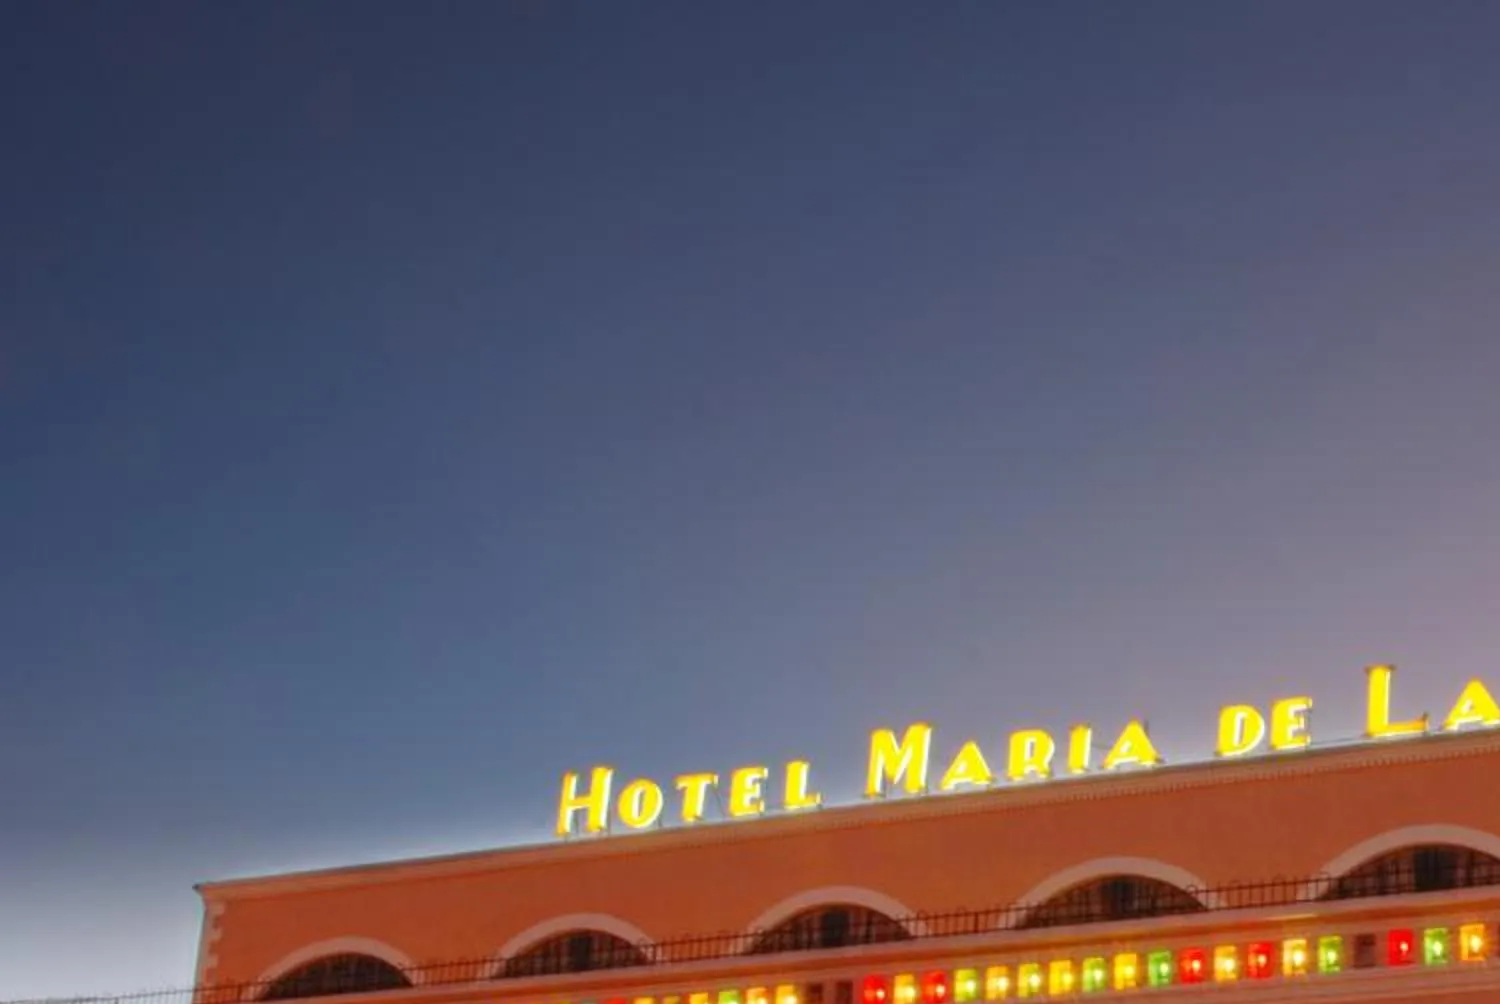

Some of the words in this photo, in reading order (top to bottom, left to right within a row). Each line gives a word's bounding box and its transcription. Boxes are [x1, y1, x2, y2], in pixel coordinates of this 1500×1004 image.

[555, 760, 823, 837] HOTEL
[863, 719, 1163, 799] MARIA
[1214, 696, 1313, 757] DE
